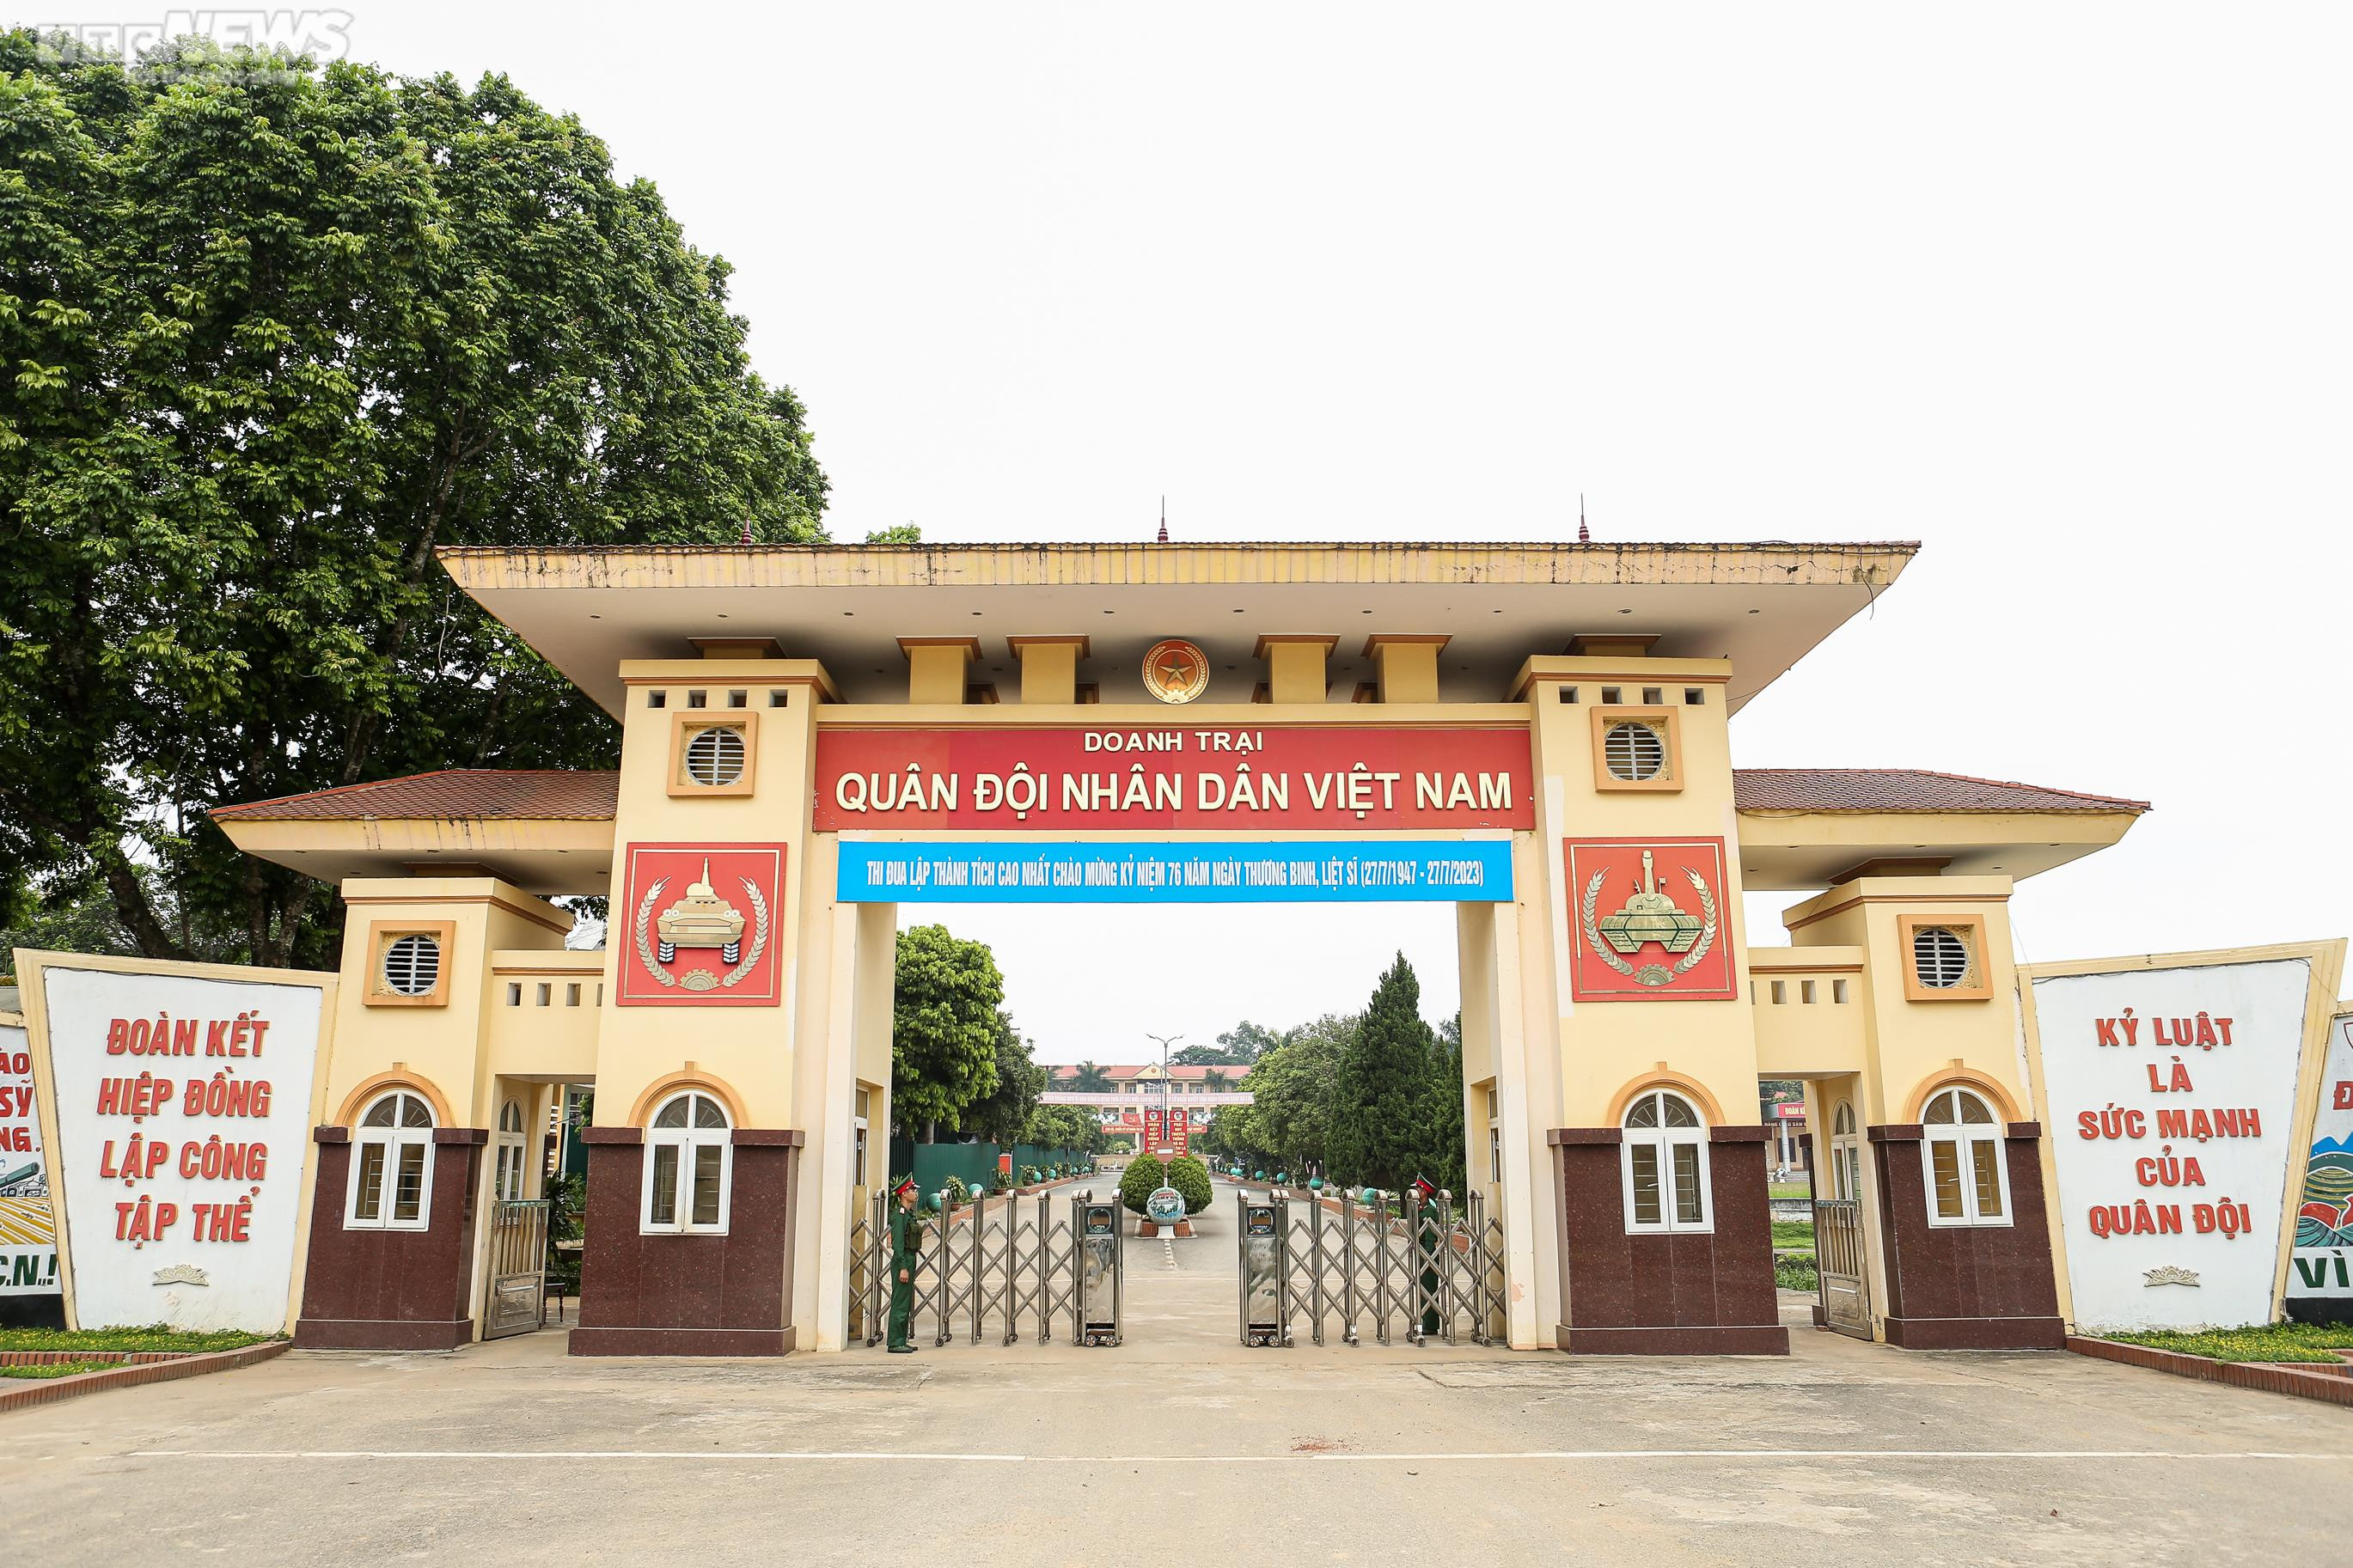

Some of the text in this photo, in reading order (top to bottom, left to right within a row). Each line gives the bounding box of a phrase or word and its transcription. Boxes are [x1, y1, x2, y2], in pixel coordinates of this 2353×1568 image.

[1085, 731, 1264, 754] DOANH TRẠI
[835, 762, 1513, 821] QUÂN ĐỘI NHÂN DÂN VIỆT NAM
[867, 861, 883, 886] THI
[886, 861, 908, 886] ĐUA
[909, 856, 931, 891] LẬP
[933, 856, 969, 886] THÀNH
[971, 856, 995, 886] TÍCH
[998, 861, 1019, 887] CAO
[1022, 853, 1051, 886] NHẤT
[1053, 857, 1082, 887] CHÀO
[1085, 857, 1117, 887] MỪNG
[1120, 853, 1134, 886] KỶ
[1137, 857, 1165, 891] NIỆM
[1167, 862, 1182, 886] 76
[1184, 857, 1210, 886] NĂM
[1213, 856, 1242, 886] NGÀY
[1244, 859, 1287, 886] THƯƠNG
[1289, 861, 1319, 888] BINH,
[1322, 856, 1344, 891] LIỆT
[1347, 856, 1358, 886] SĨ
[1360, 860, 1417, 888] (27/7/1947
[1427, 860, 1484, 887] 27/7/2023)
[107, 1010, 270, 1057] ĐOÀN KẾT
[2095, 1007, 2234, 1051] KỶ LUẬT
[97, 1066, 272, 1124] HIỆP ĐỒNG
[2147, 1056, 2194, 1093] LÀ
[2077, 1103, 2262, 1143] SỨC MẠNH
[100, 1132, 268, 1187] LẬP CÔNG
[2135, 1144, 2206, 1187] CỦA
[115, 1186, 260, 1250] TẬP THỂ
[2088, 1197, 2252, 1239] QUÂN ĐỘI
[2292, 1249, 2350, 1289] VÌ
